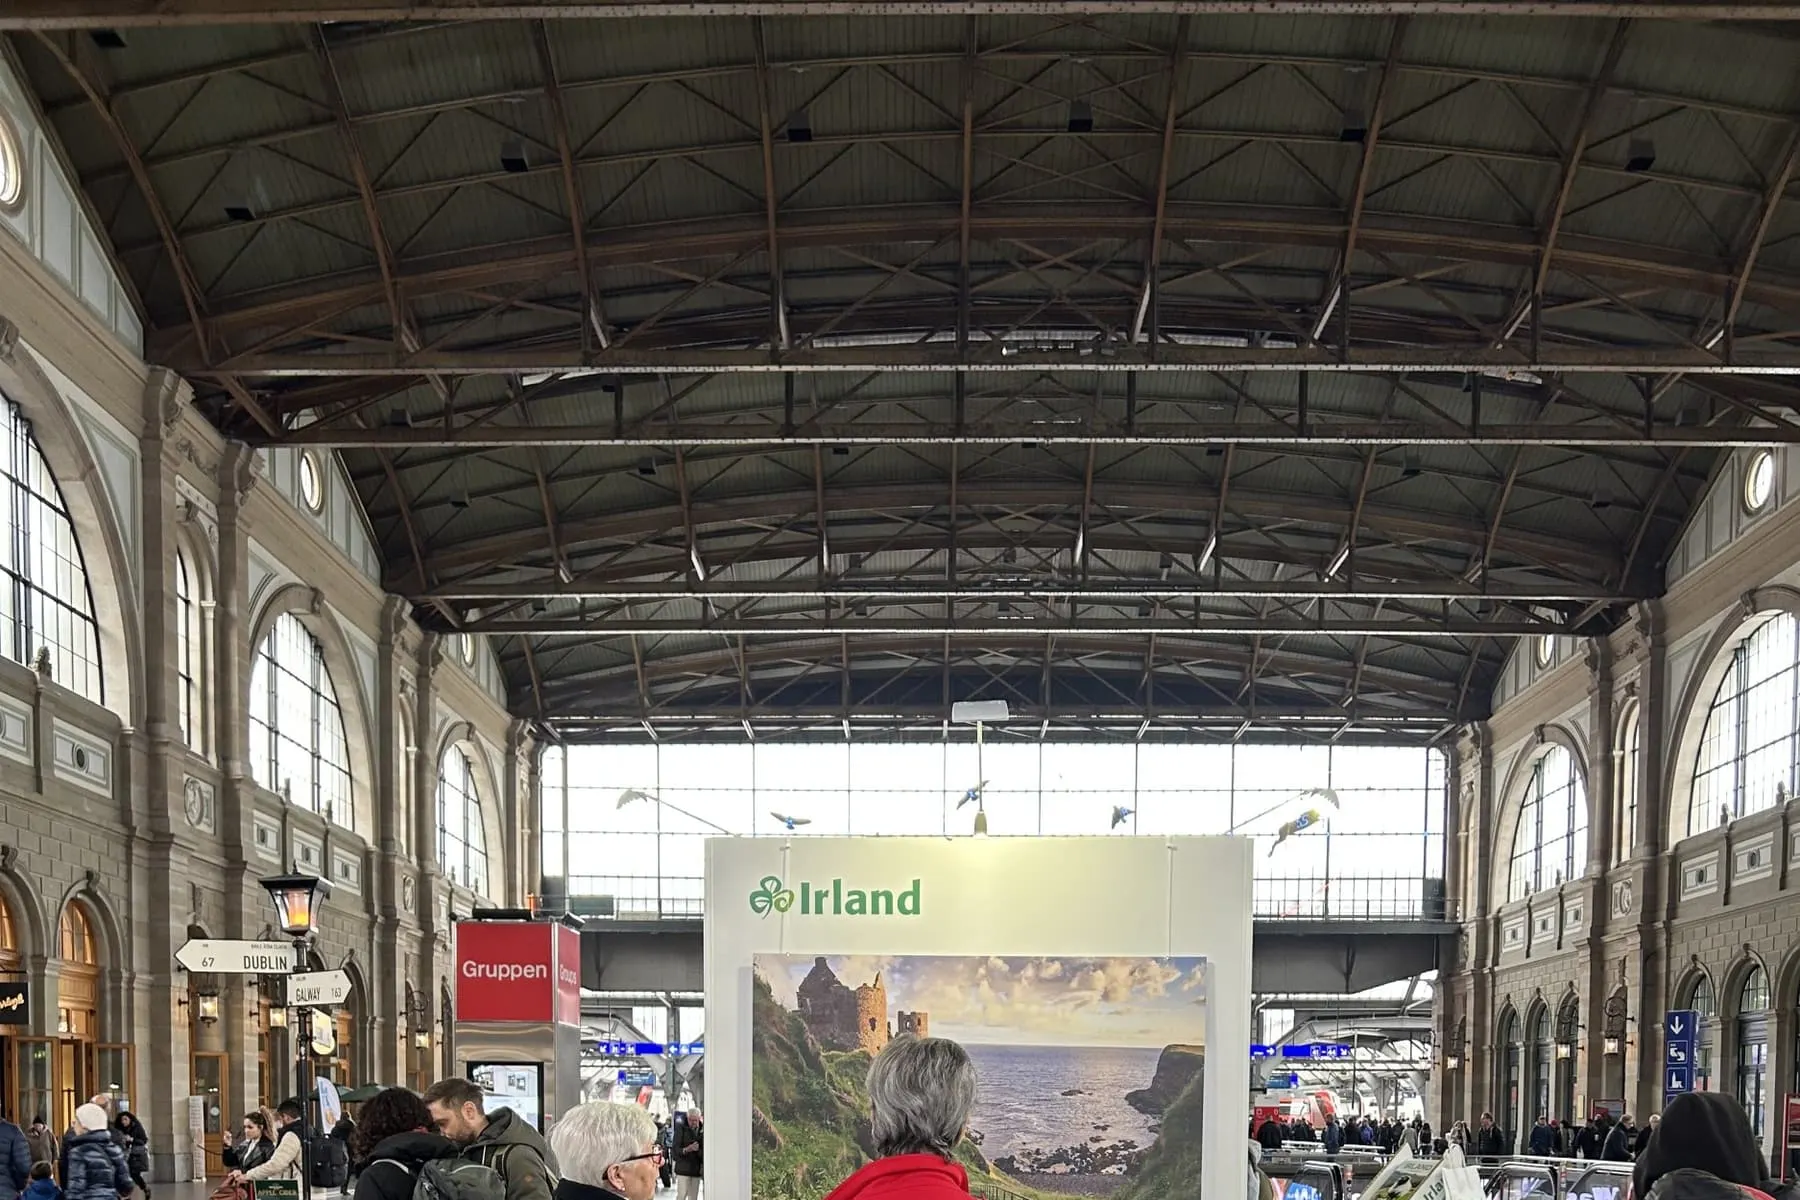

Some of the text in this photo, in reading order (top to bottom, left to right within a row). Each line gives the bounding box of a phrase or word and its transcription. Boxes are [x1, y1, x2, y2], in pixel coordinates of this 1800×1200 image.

[801, 879, 920, 915] Irland
[202, 955, 287, 970] 67 DUBLIN
[462, 960, 547, 981] Gruppen
[296, 988, 320, 1001] GALWAY
